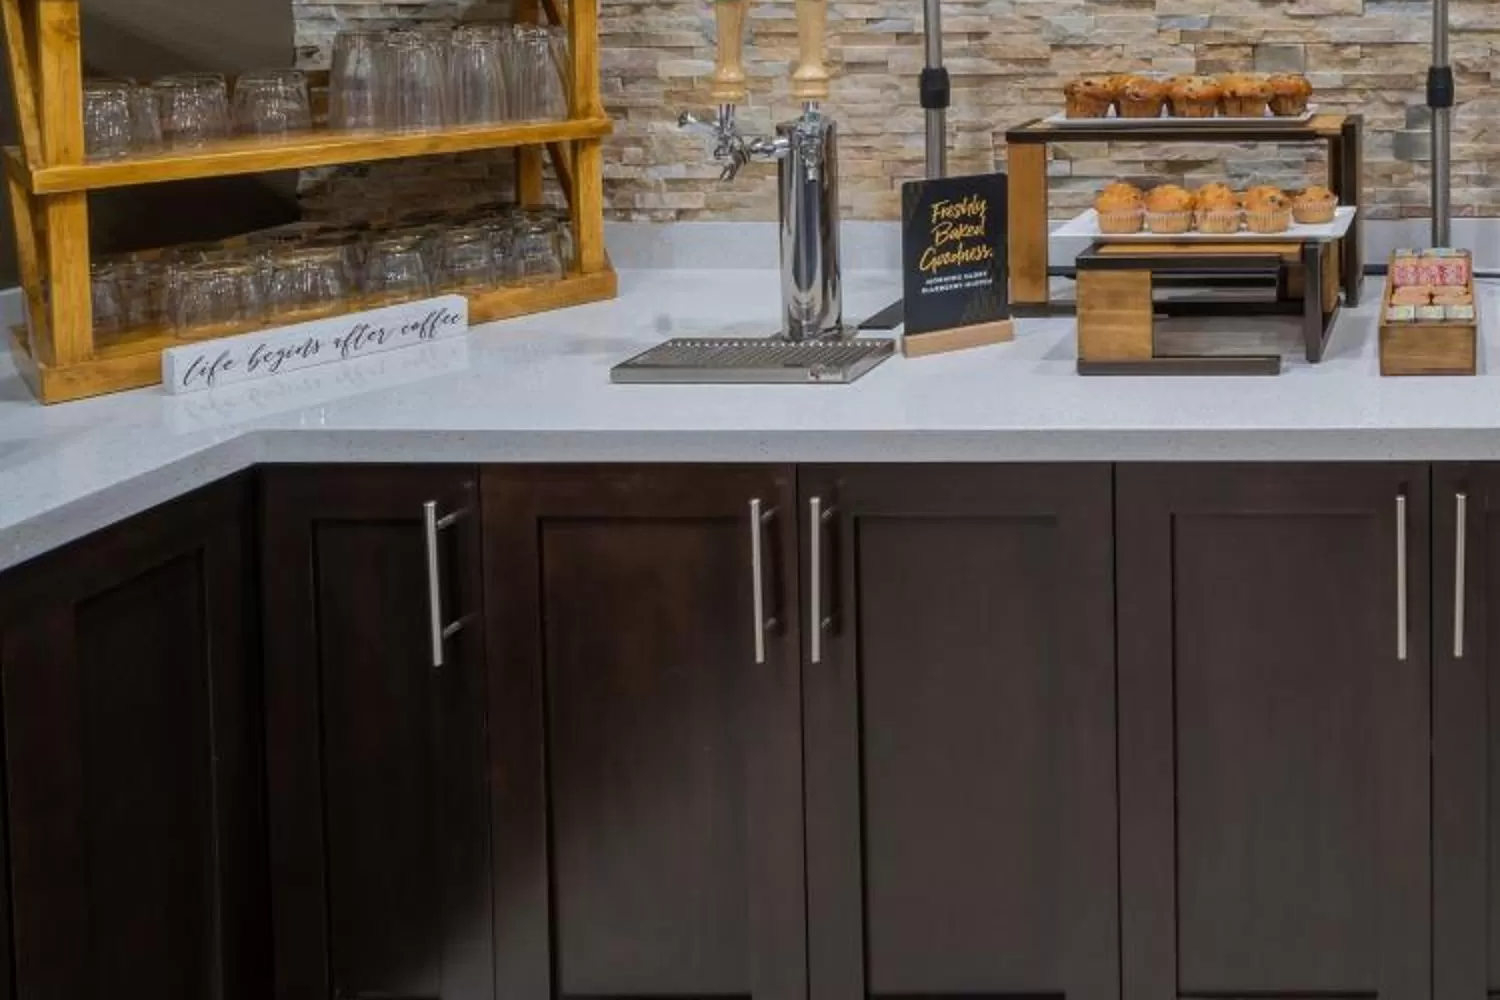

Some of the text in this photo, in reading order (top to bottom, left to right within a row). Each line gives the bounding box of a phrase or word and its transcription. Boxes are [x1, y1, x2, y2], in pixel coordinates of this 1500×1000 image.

[931, 194, 987, 223] Freshly
[931, 215, 986, 246] Baked
[919, 241, 993, 274] Goodness.
[183, 307, 463, 388] life begins after coffee
